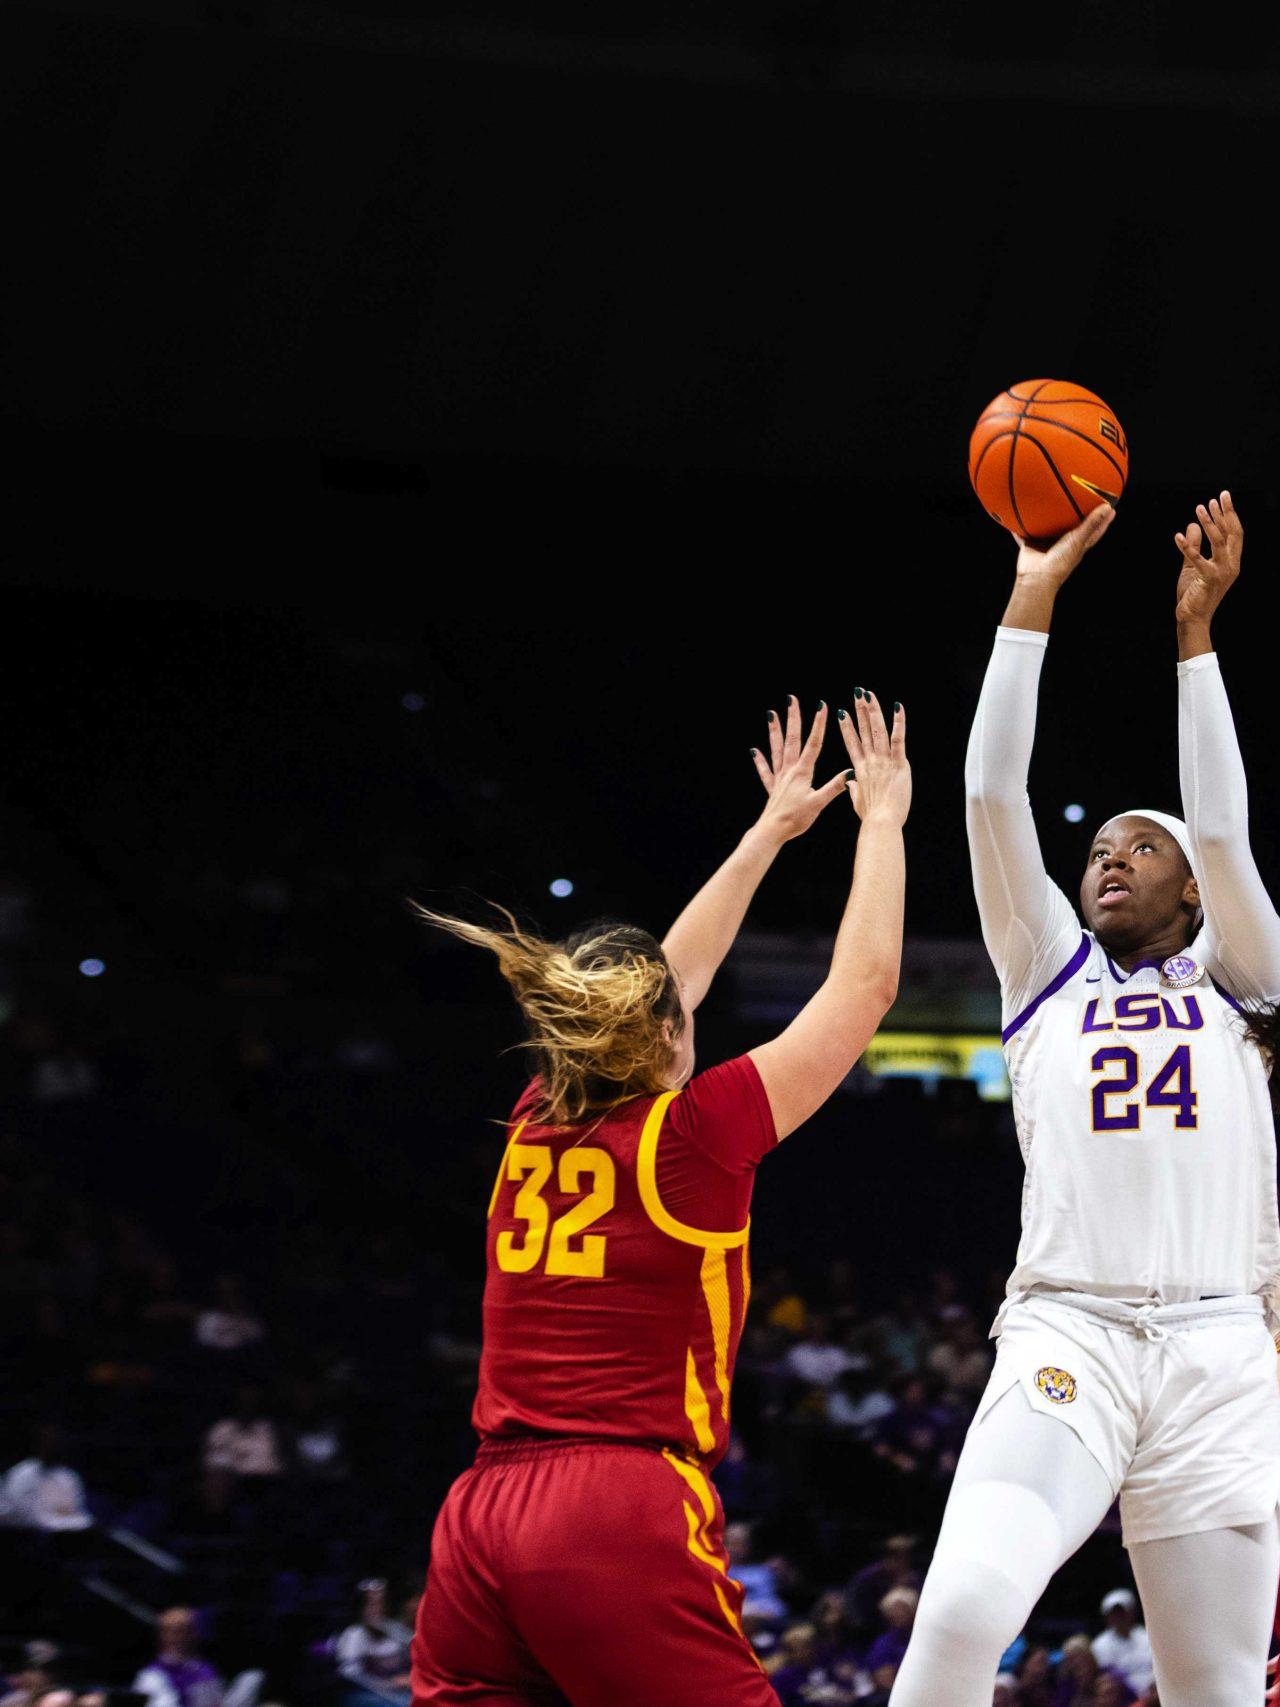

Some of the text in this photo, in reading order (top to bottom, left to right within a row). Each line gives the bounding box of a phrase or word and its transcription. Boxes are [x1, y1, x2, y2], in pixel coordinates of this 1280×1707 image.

[1163, 958, 1195, 980] SEC
[1081, 993, 1204, 1034] LSU
[1091, 1044, 1198, 1132] 24
[496, 1144, 616, 1278] 32
